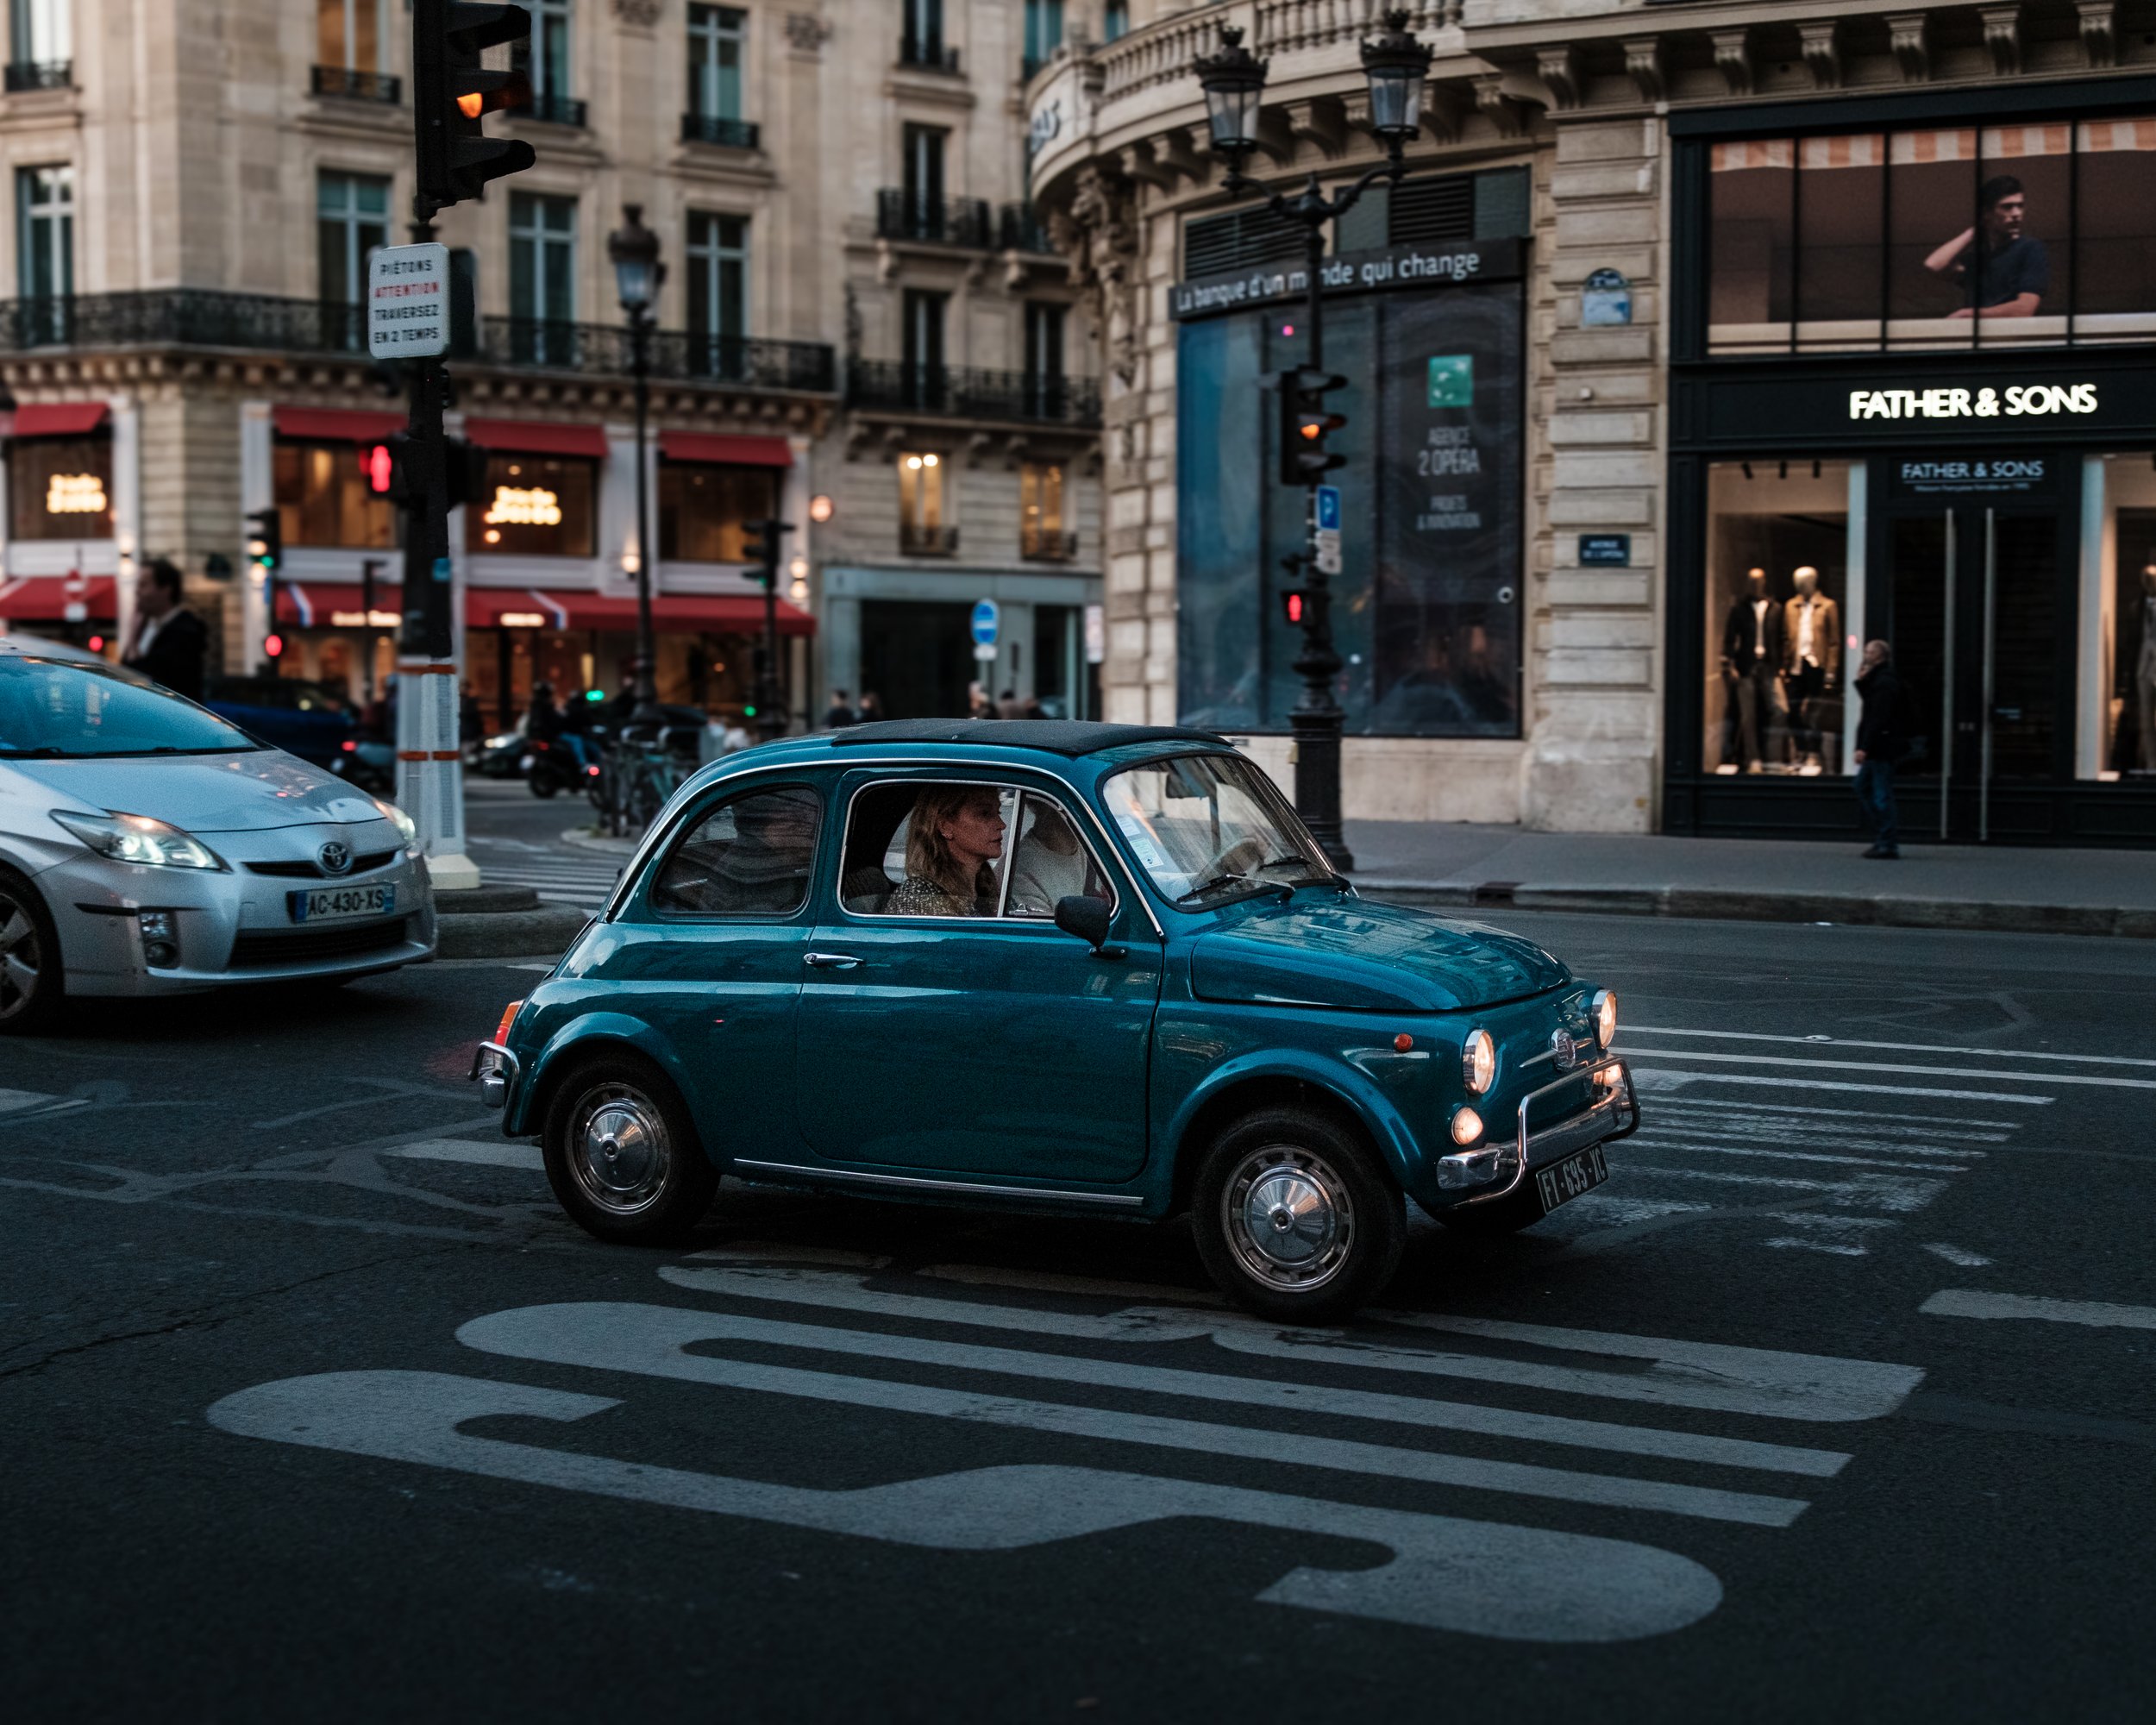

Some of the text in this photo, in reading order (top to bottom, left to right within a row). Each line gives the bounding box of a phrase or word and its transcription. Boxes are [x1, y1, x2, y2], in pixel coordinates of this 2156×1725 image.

[374, 281, 439, 298] ATTENTION
[1177, 289, 1192, 311] La
[1194, 281, 1246, 308] banque
[1361, 256, 1394, 286] qui
[1398, 252, 1479, 280] change
[374, 304, 439, 321] TRAVERSEZ
[374, 327, 439, 344] EN 2 TEMPS
[1849, 384, 2097, 419] FATHER & SONS
[1418, 449, 1430, 476] 2
[1902, 461, 2044, 479] FATHER & SONS
